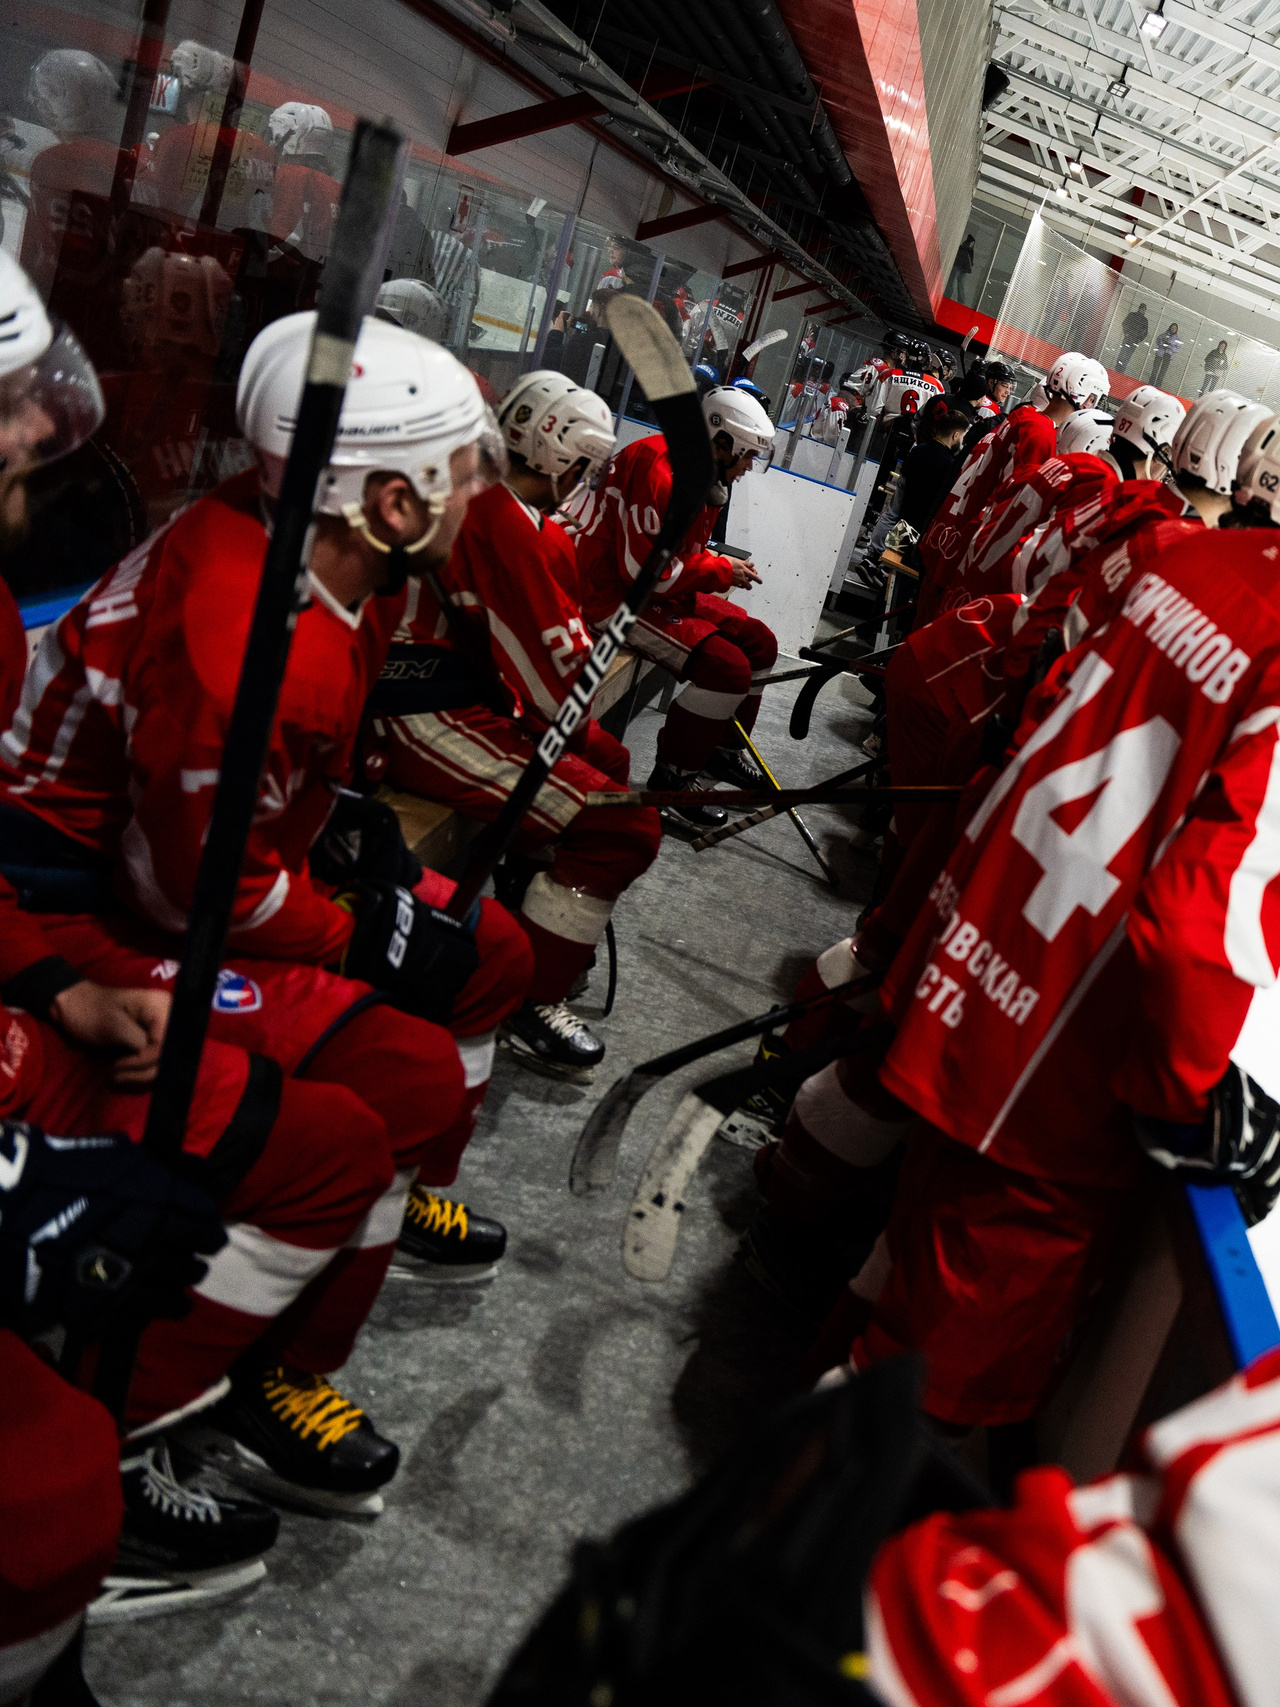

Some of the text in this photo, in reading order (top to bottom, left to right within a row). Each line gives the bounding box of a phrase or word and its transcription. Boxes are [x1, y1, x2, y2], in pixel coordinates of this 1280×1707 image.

[901, 390, 920, 415] 6
[541, 415, 557, 433] 3
[1118, 418, 1133, 433] 87
[1258, 470, 1279, 493] 62
[630, 503, 662, 536] 10
